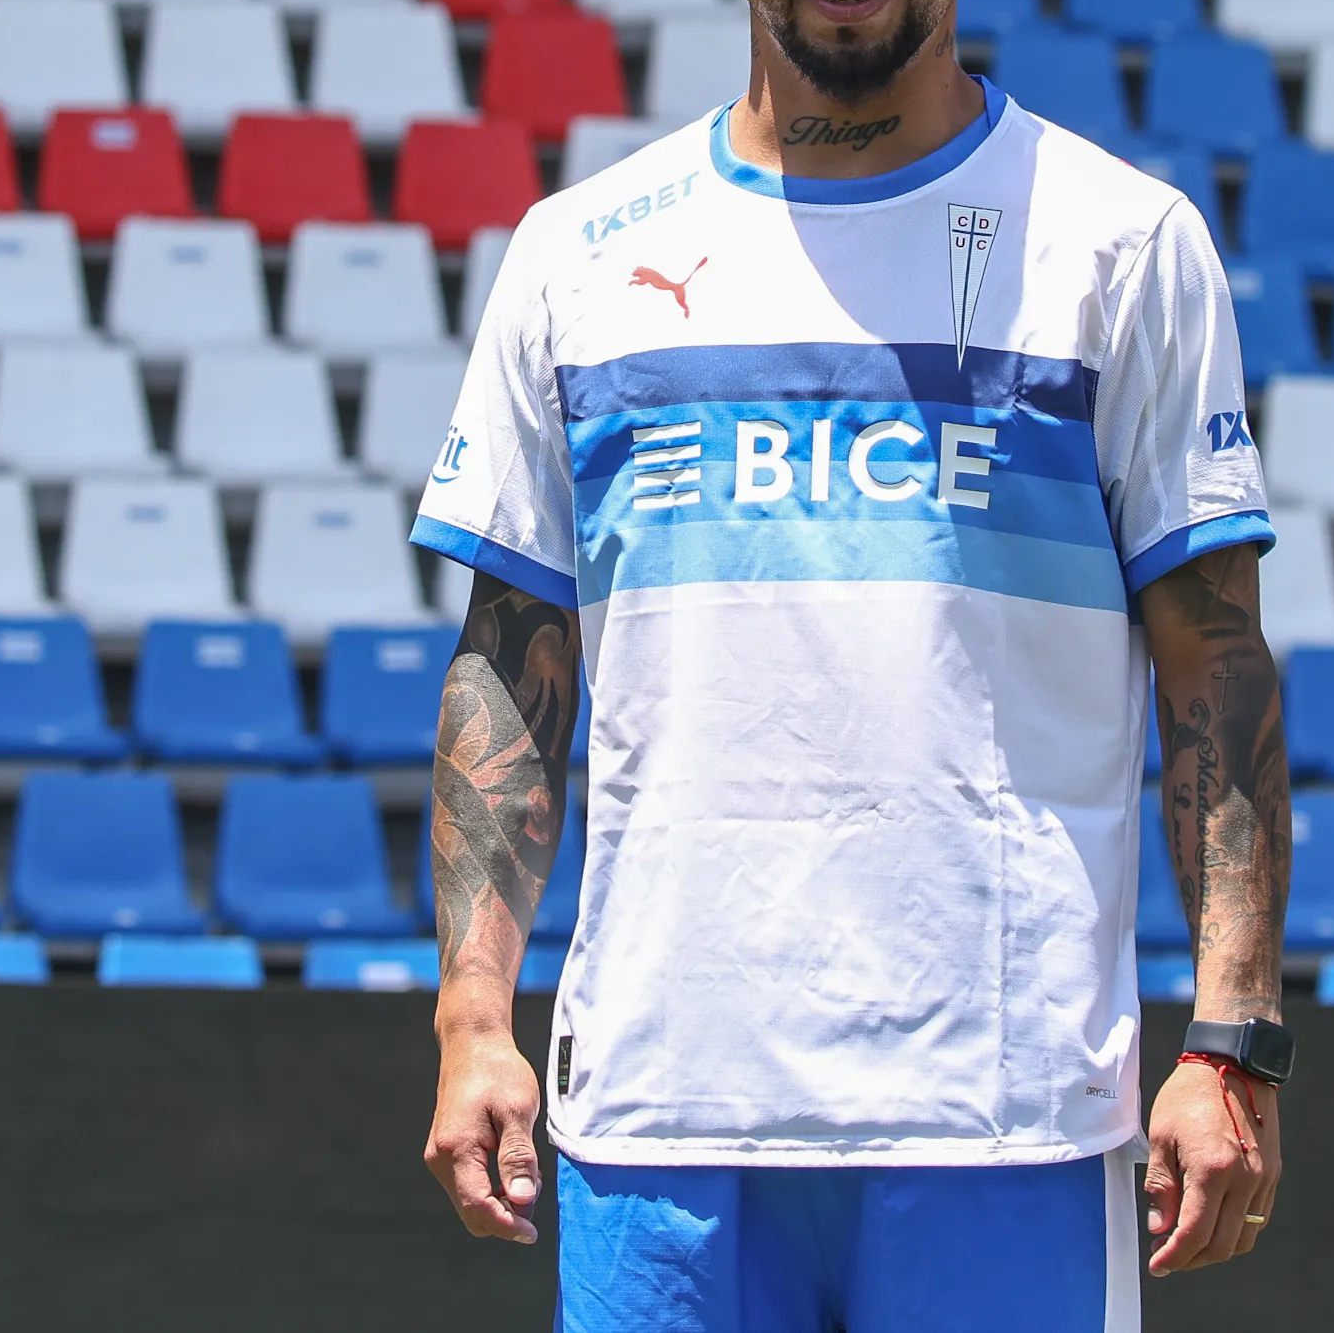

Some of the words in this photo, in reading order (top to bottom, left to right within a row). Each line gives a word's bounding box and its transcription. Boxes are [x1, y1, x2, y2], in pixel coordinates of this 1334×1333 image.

[783, 115, 901, 151] Thiago
[581, 170, 700, 245] 1XBET
[734, 418, 998, 511] BICE
[1086, 1086, 1119, 1100] DRYCELL
